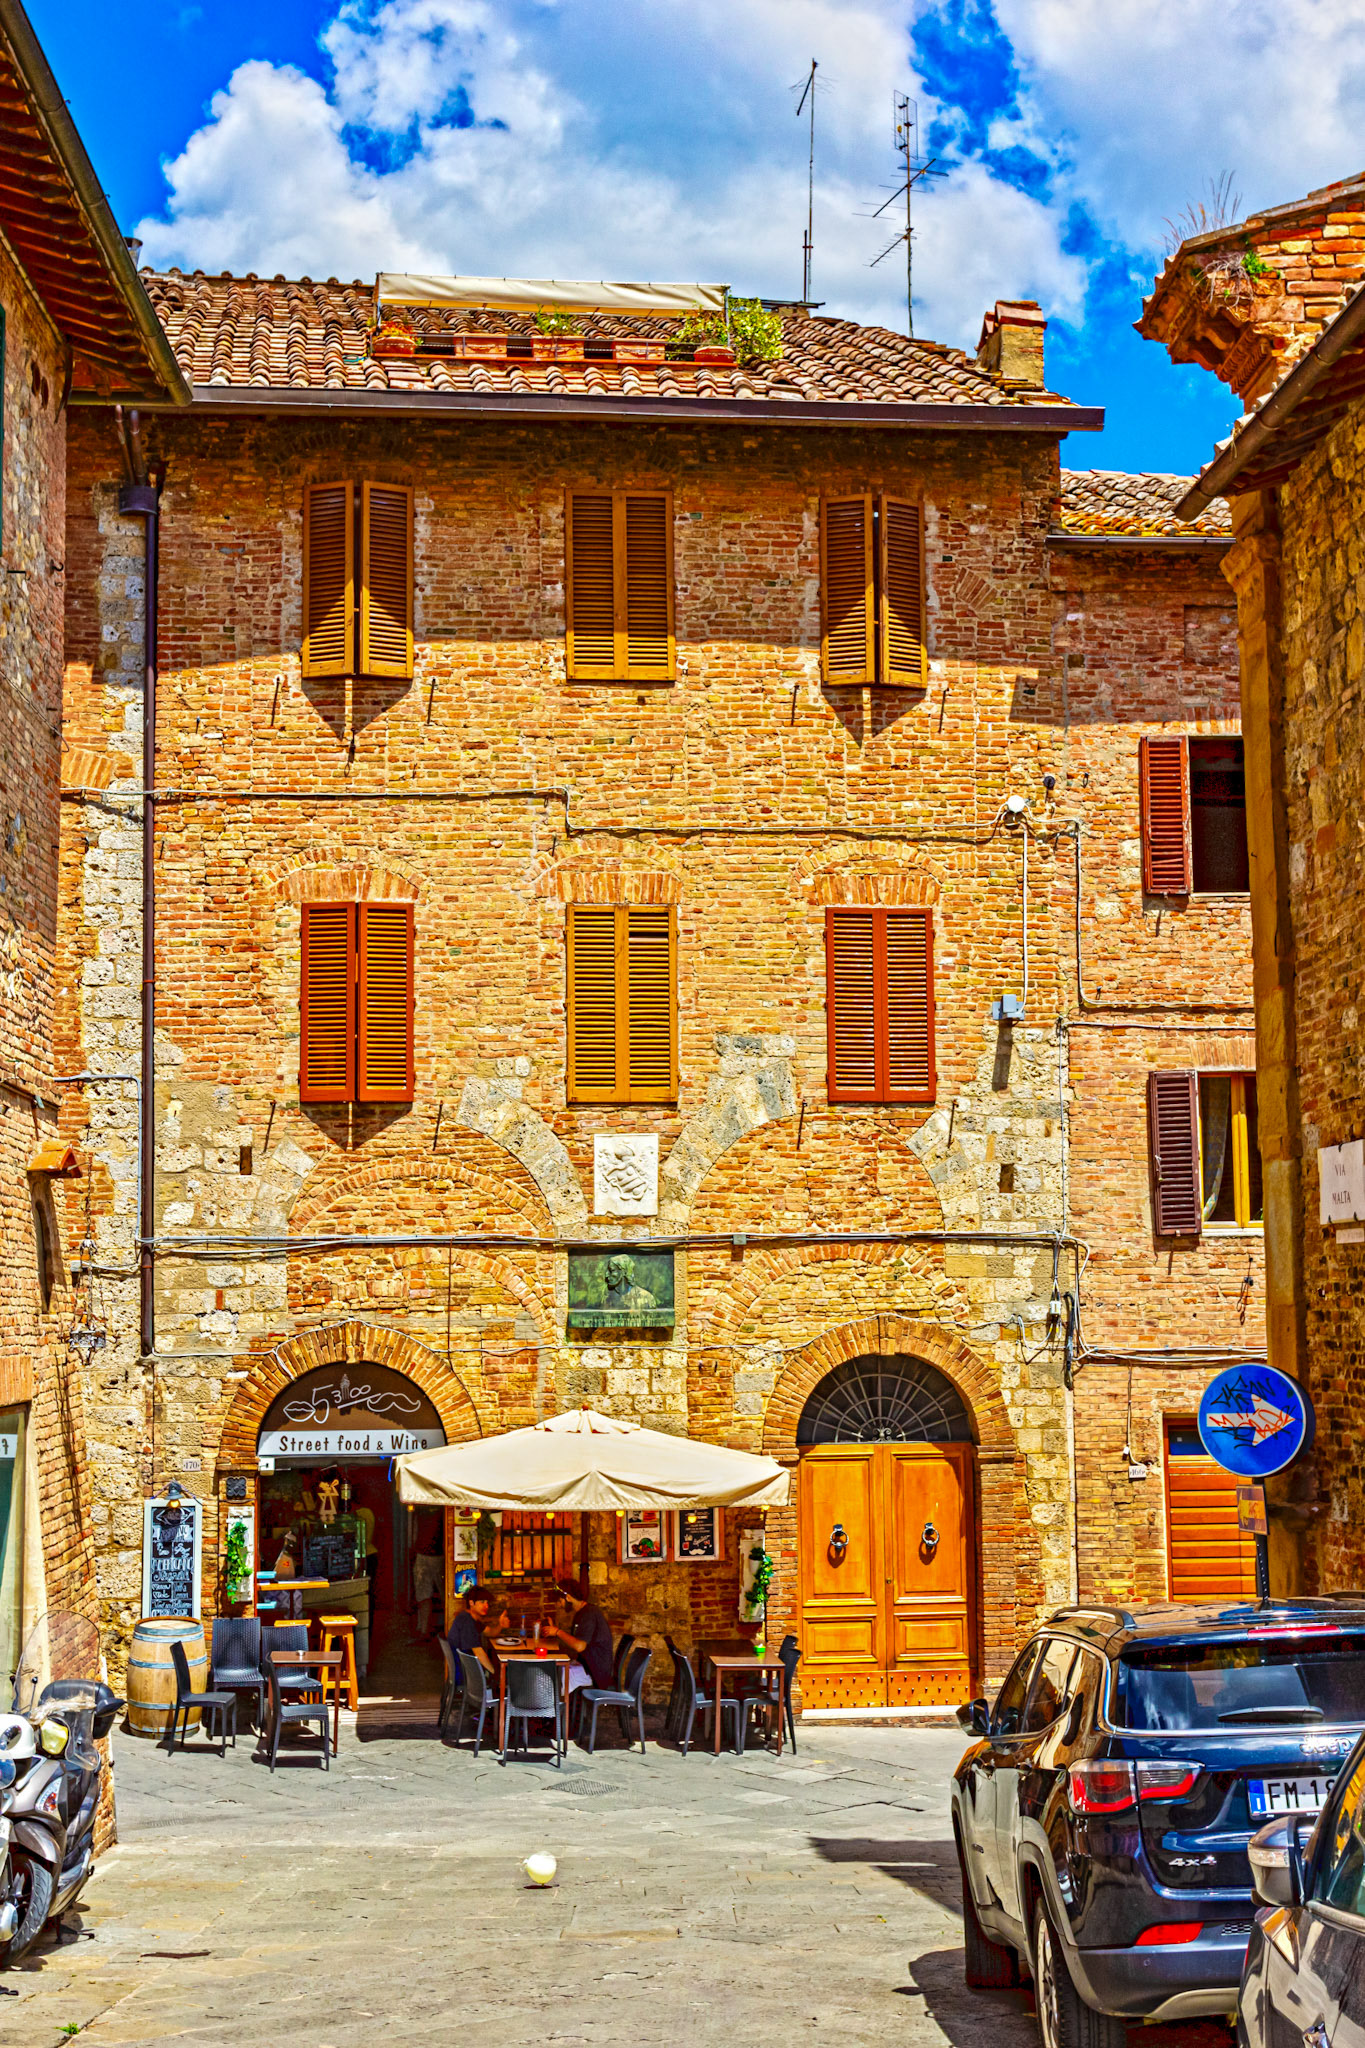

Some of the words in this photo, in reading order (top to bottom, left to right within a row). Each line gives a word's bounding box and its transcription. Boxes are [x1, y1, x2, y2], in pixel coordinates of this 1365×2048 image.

[1334, 1163, 1346, 1177] VIA
[1332, 1190, 1351, 1205] MALTA
[279, 1435, 329, 1452] Street
[337, 1434, 370, 1451] food
[376, 1442, 384, 1450] &
[391, 1434, 428, 1450] Wine
[185, 1461, 198, 1469] 170
[1299, 1735, 1352, 1756] Jeep
[1267, 1782, 1300, 1810] FM
[1168, 1855, 1218, 1867] 4x4
